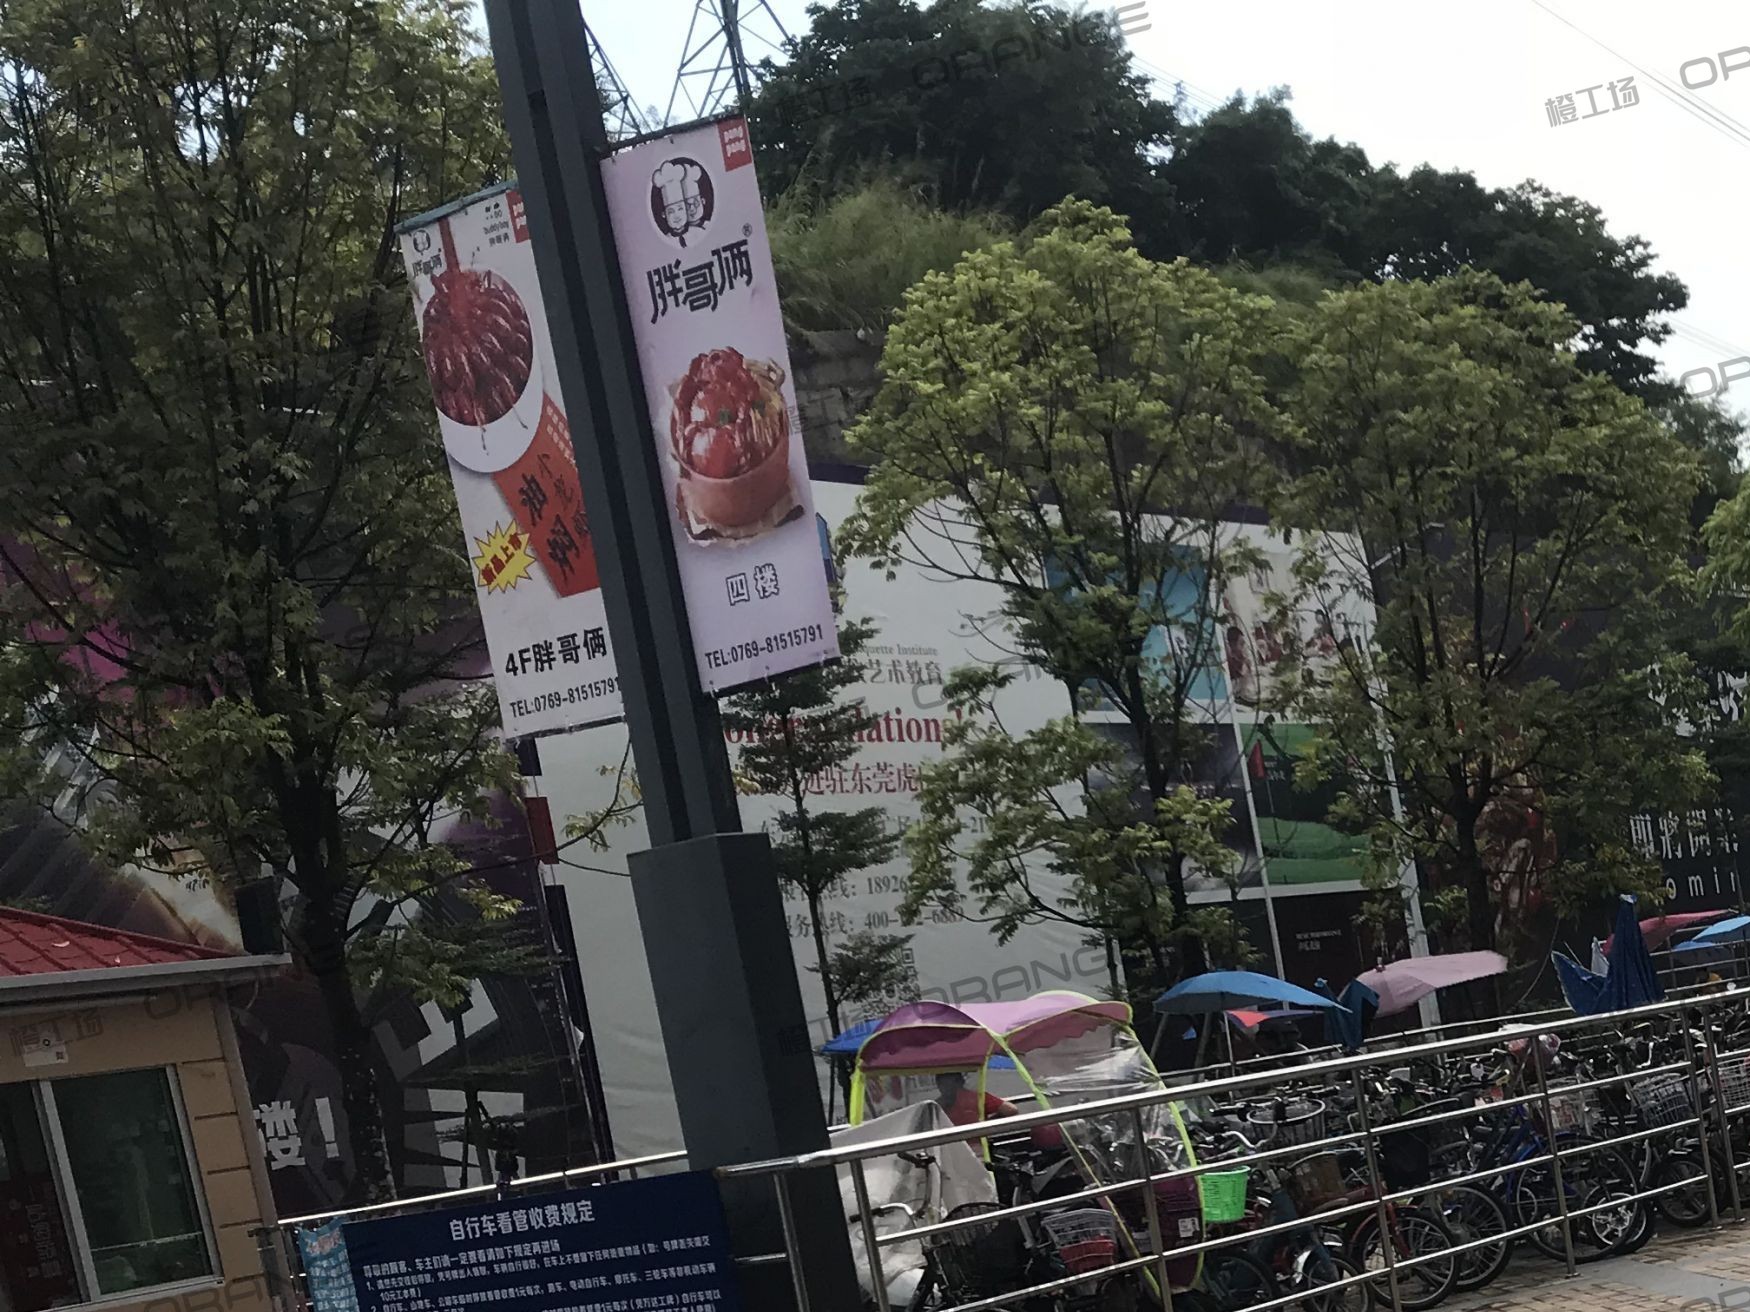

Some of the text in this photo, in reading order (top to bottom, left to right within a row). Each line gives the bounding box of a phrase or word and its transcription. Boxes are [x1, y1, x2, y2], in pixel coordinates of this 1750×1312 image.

[646, 239, 753, 324] 胖哥俩
[481, 531, 523, 586] 新品上市
[726, 563, 780, 606] 四楼
[505, 627, 608, 677] 4F胖哥俩
[704, 624, 824, 670] TEL:0769-81515791
[509, 676, 621, 719] TEL:0769-81515791
[448, 1199, 595, 1240] 自行车看管收费规定
